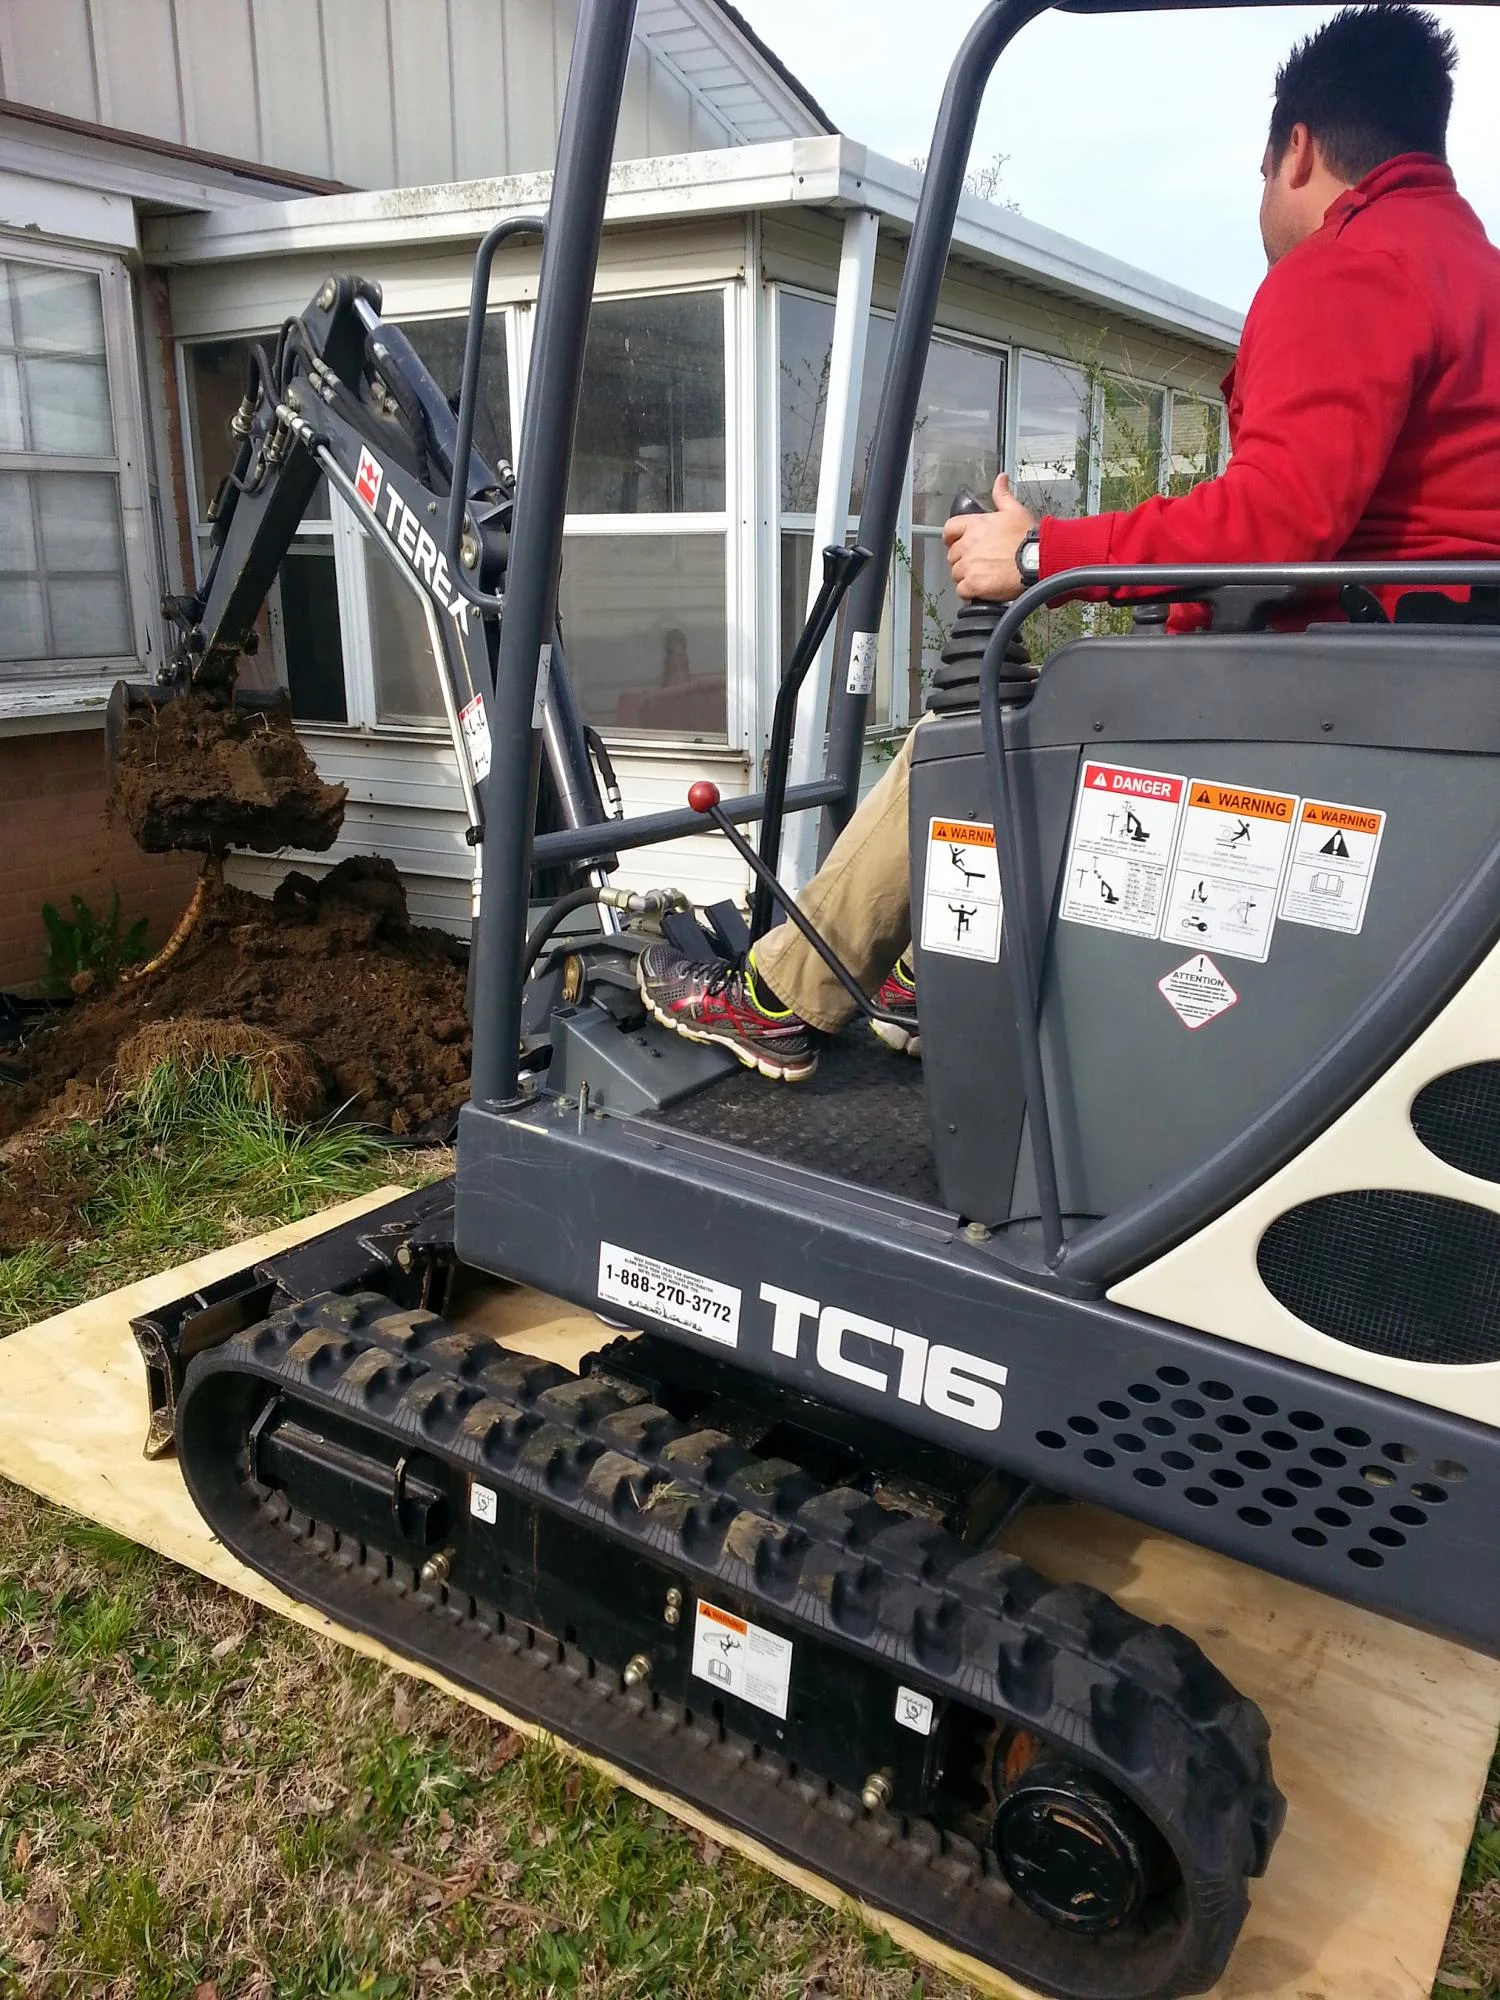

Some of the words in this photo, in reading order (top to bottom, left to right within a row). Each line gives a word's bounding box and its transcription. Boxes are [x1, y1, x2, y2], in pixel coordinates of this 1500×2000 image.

[386, 482, 470, 636] TEREX
[1112, 774, 1172, 798] DANGER
[1218, 792, 1288, 817] WARNING
[1321, 810, 1377, 830] WARNING
[951, 827, 995, 843] WARNIN
[1173, 972, 1224, 987] ATTENTION
[607, 1264, 732, 1323] 1-888-270-3772
[760, 1282, 1008, 1431] TC16
